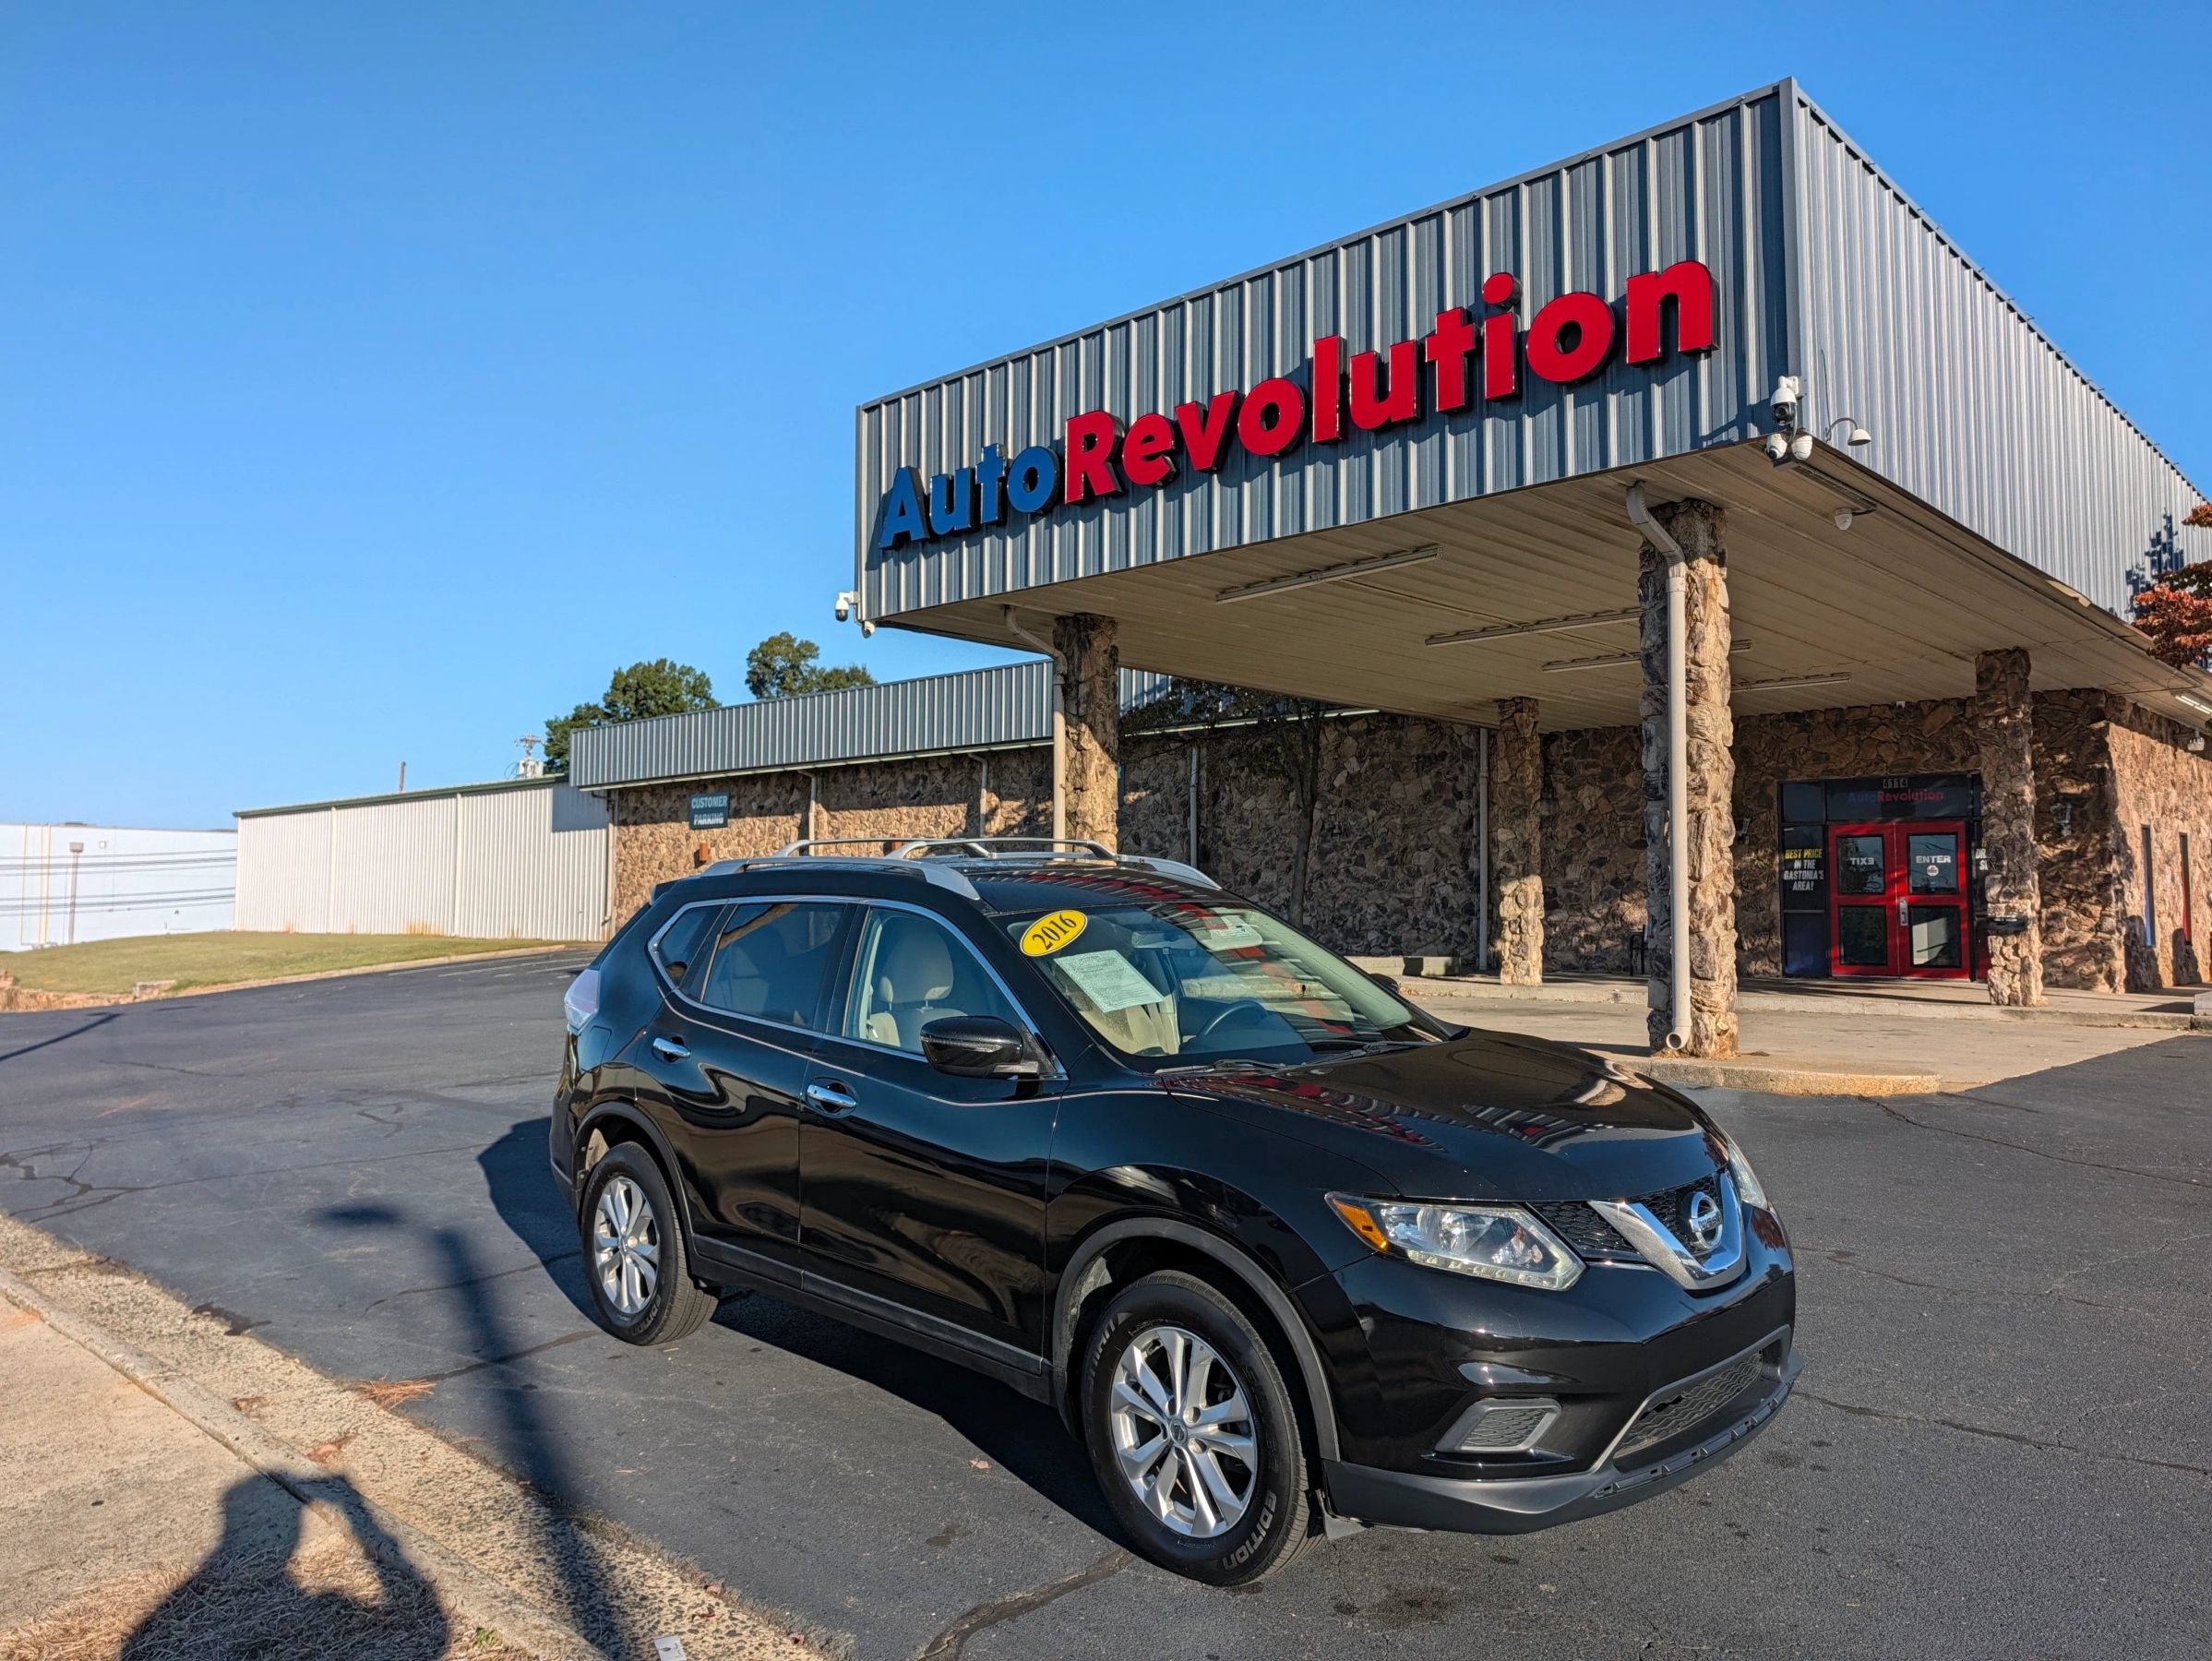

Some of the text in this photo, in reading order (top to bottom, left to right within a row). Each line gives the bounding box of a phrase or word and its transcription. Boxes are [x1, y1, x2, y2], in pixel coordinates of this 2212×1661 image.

[691, 795, 728, 809] CUSTOMER
[693, 812, 723, 825] PARKING
[1786, 849, 1823, 859] BEST PRICE
[1916, 854, 1951, 864] ENTER
[1794, 859, 1816, 869] IN THE
[1784, 870, 1824, 880] GASTONIA'S
[1792, 881, 1814, 891] AREA!
[1032, 913, 1077, 950] 2016
[1223, 1489, 1277, 1570] EDITION
